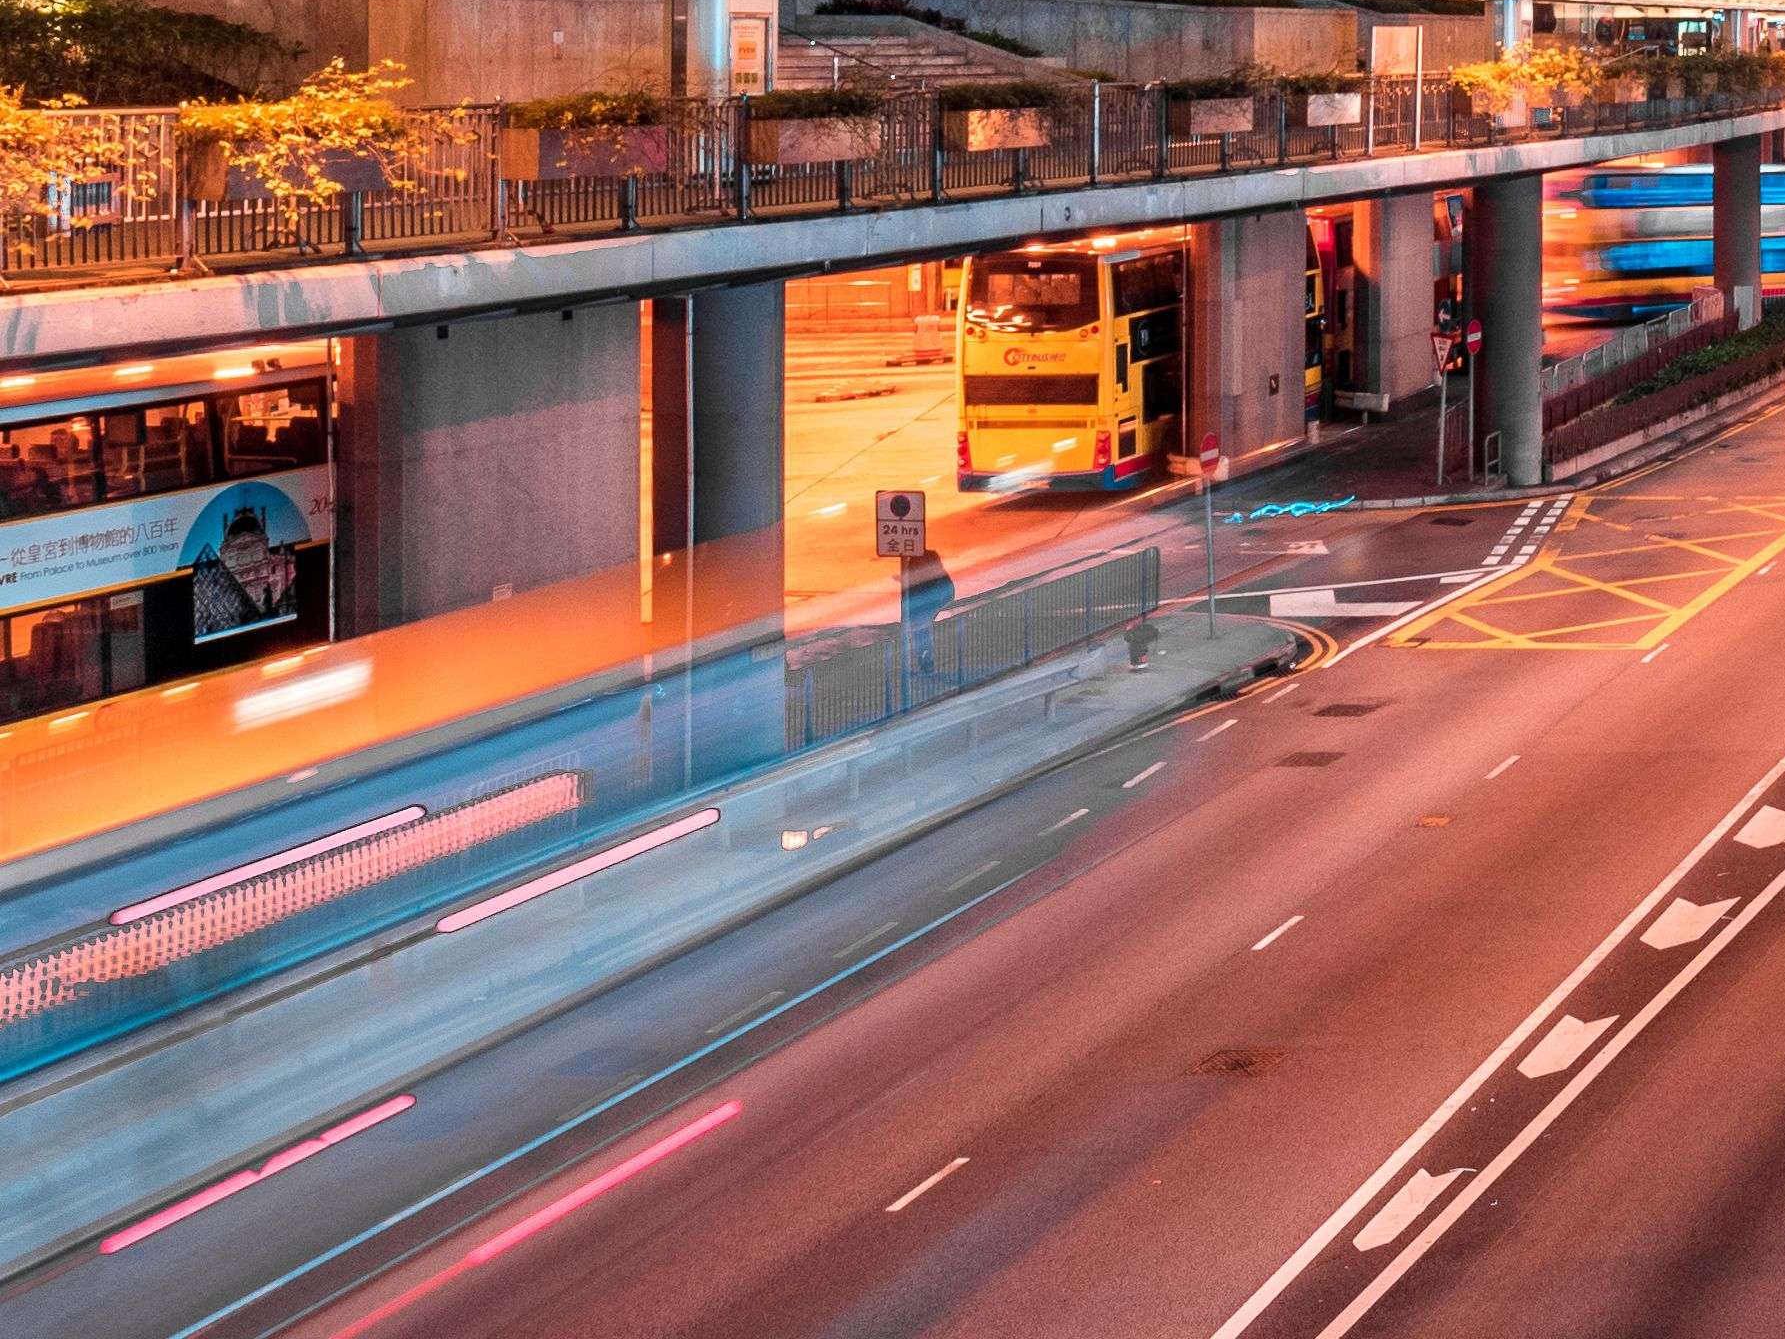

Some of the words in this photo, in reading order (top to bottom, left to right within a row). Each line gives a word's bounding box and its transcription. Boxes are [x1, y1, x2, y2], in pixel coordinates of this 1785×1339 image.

[882, 524, 898, 535] 24
[901, 525, 919, 536] hrs
[887, 538, 915, 552] 全日
[43, 564, 74, 577] Palace
